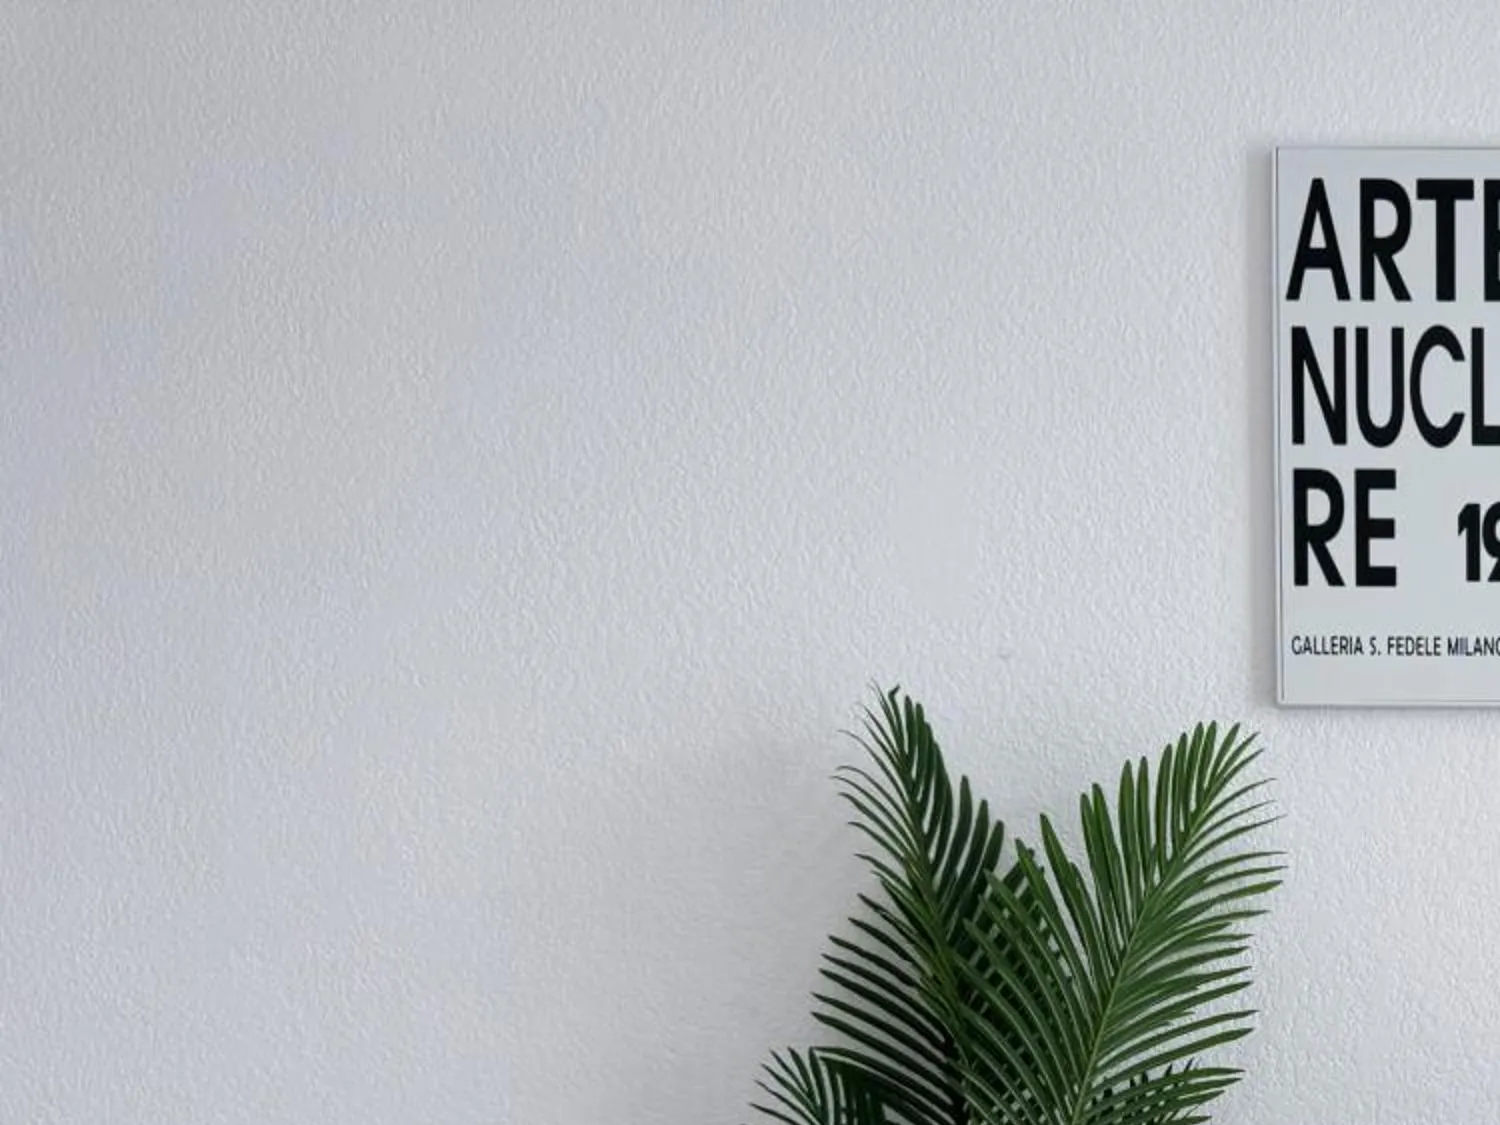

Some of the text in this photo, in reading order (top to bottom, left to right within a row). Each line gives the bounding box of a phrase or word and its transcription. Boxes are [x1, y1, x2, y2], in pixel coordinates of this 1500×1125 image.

[1292, 468, 1397, 588] RE
[1291, 635, 1364, 657] GALLERIA
[1369, 636, 1381, 657] S.
[1387, 636, 1442, 657] FEDELE
